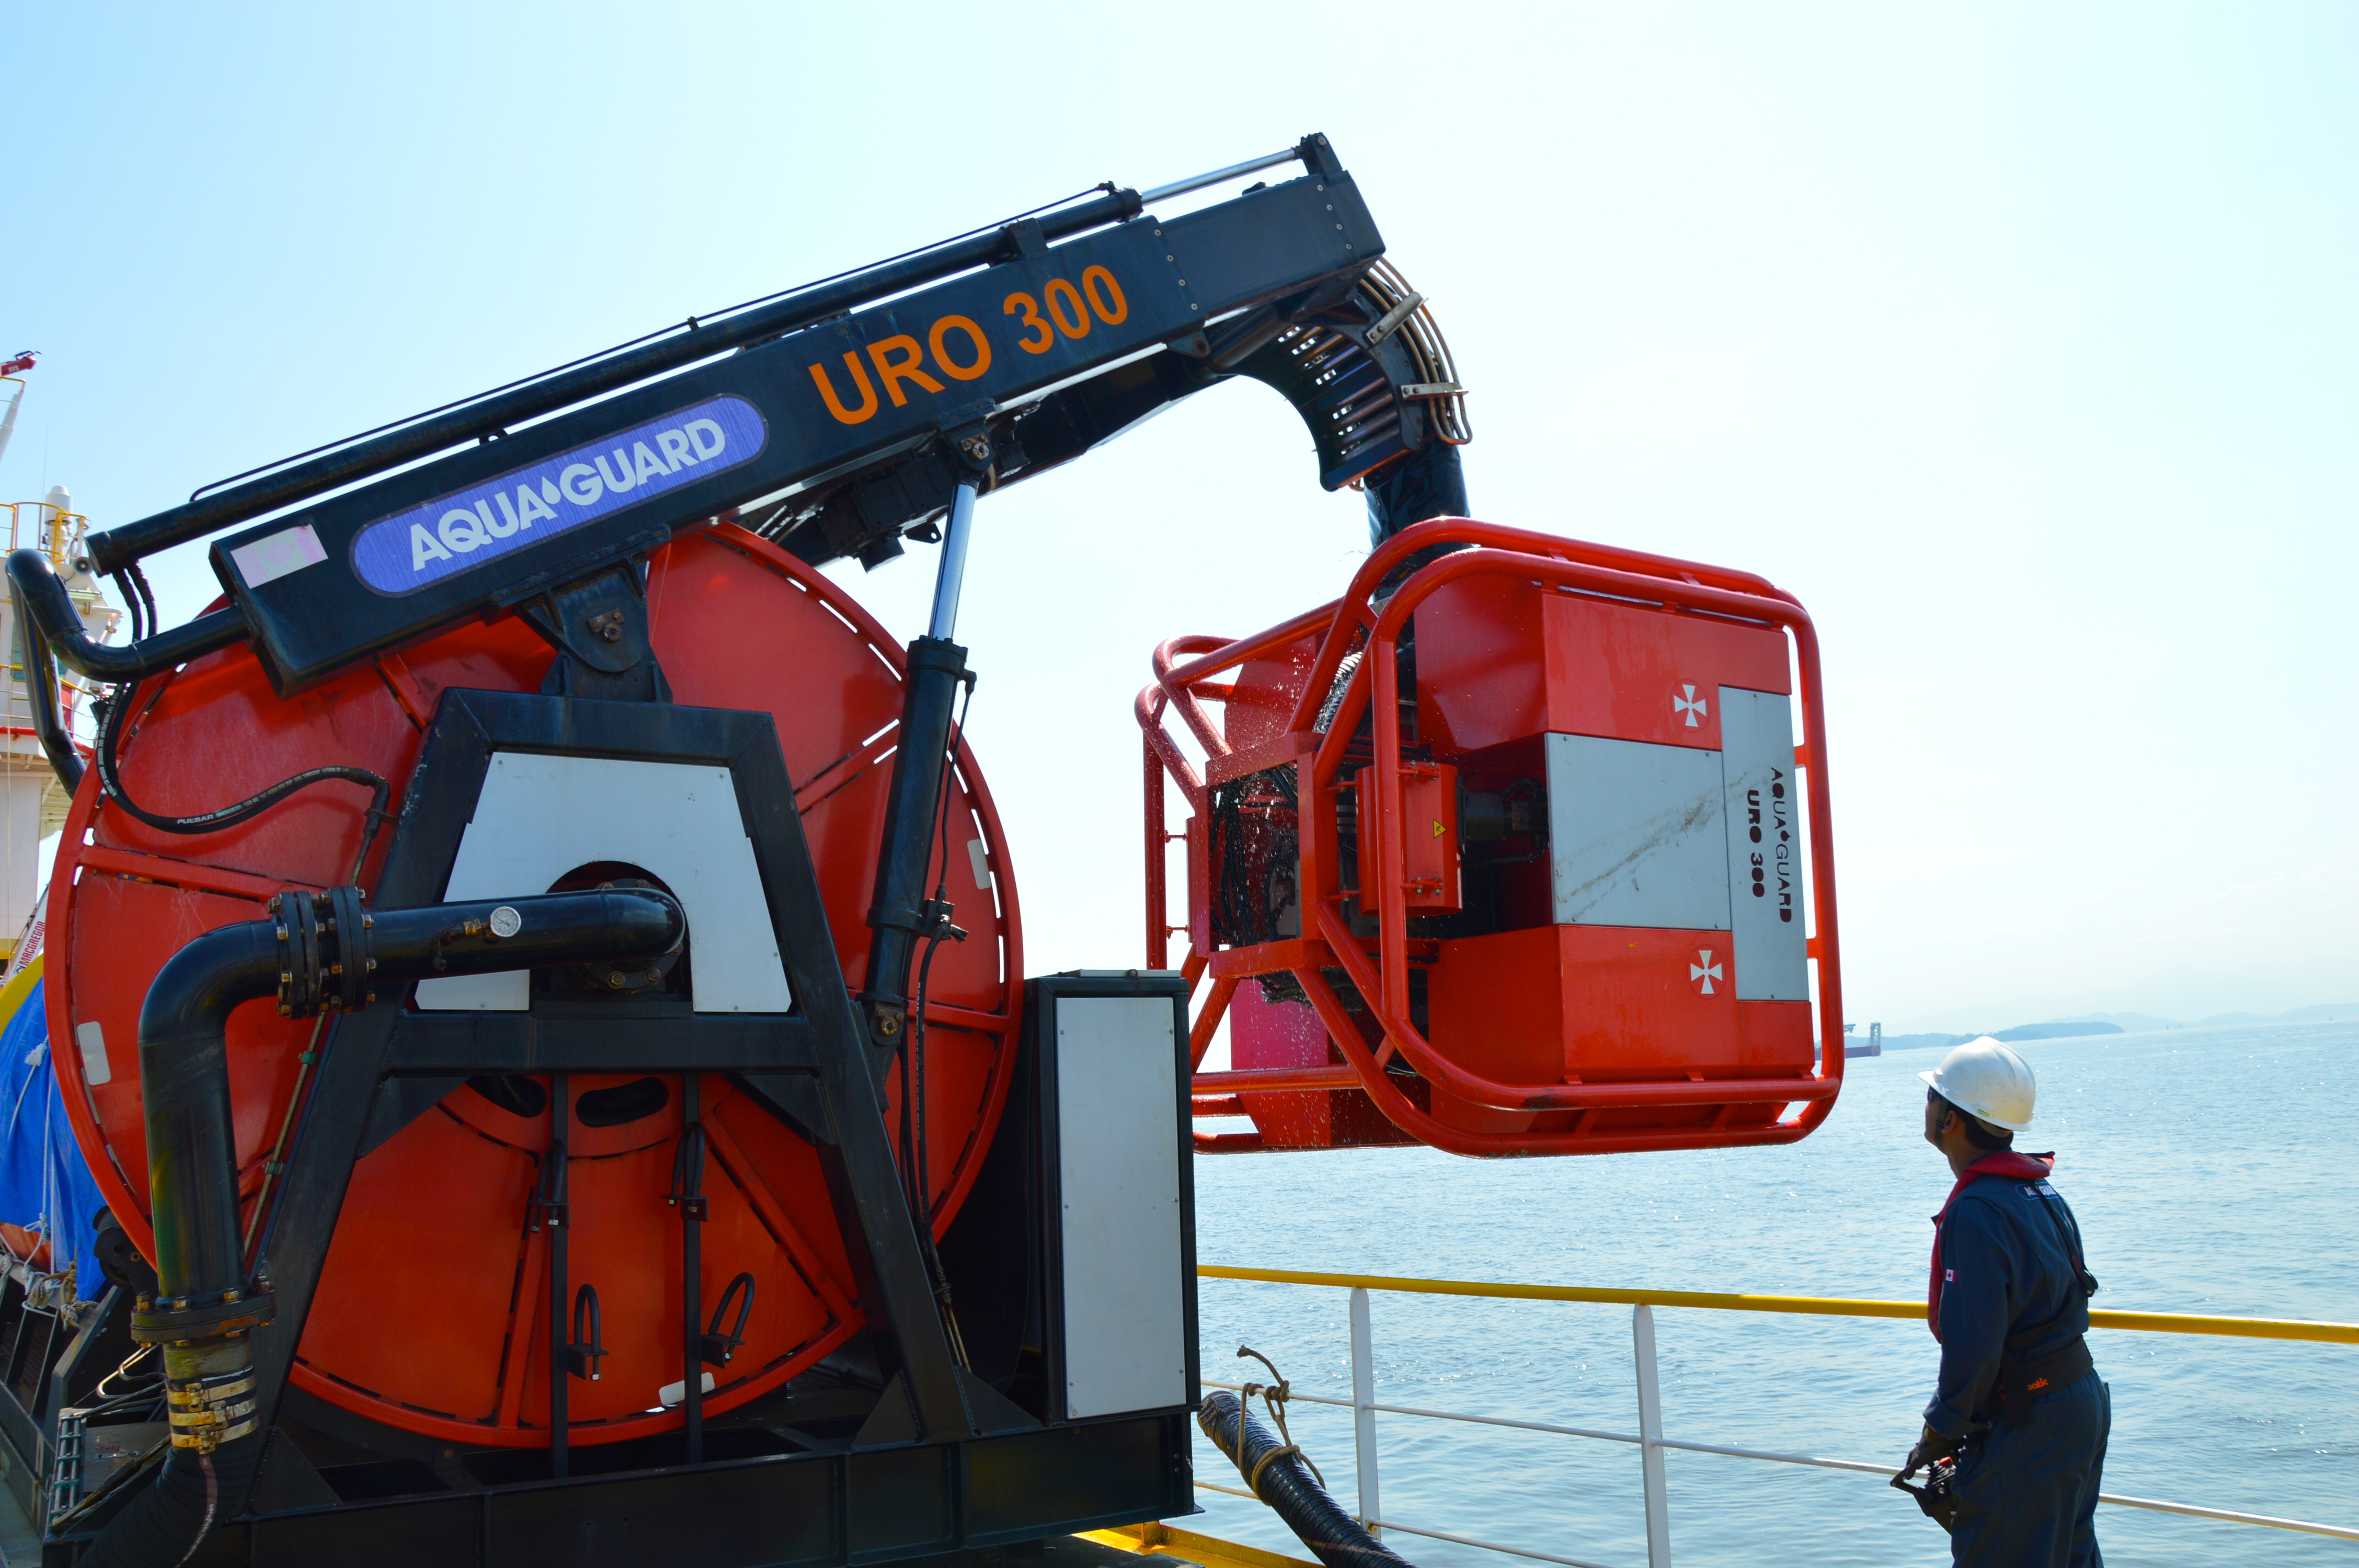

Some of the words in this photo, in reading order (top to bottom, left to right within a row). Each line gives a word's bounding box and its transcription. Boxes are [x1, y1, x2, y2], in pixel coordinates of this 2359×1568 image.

[808, 315, 992, 425] URO
[1003, 264, 1128, 354] 300
[177, 814, 214, 824] PULSAR
[1747, 789, 1762, 844] URO
[1750, 852, 1766, 898] 300
[19, 921, 46, 966] MACGREGOR
